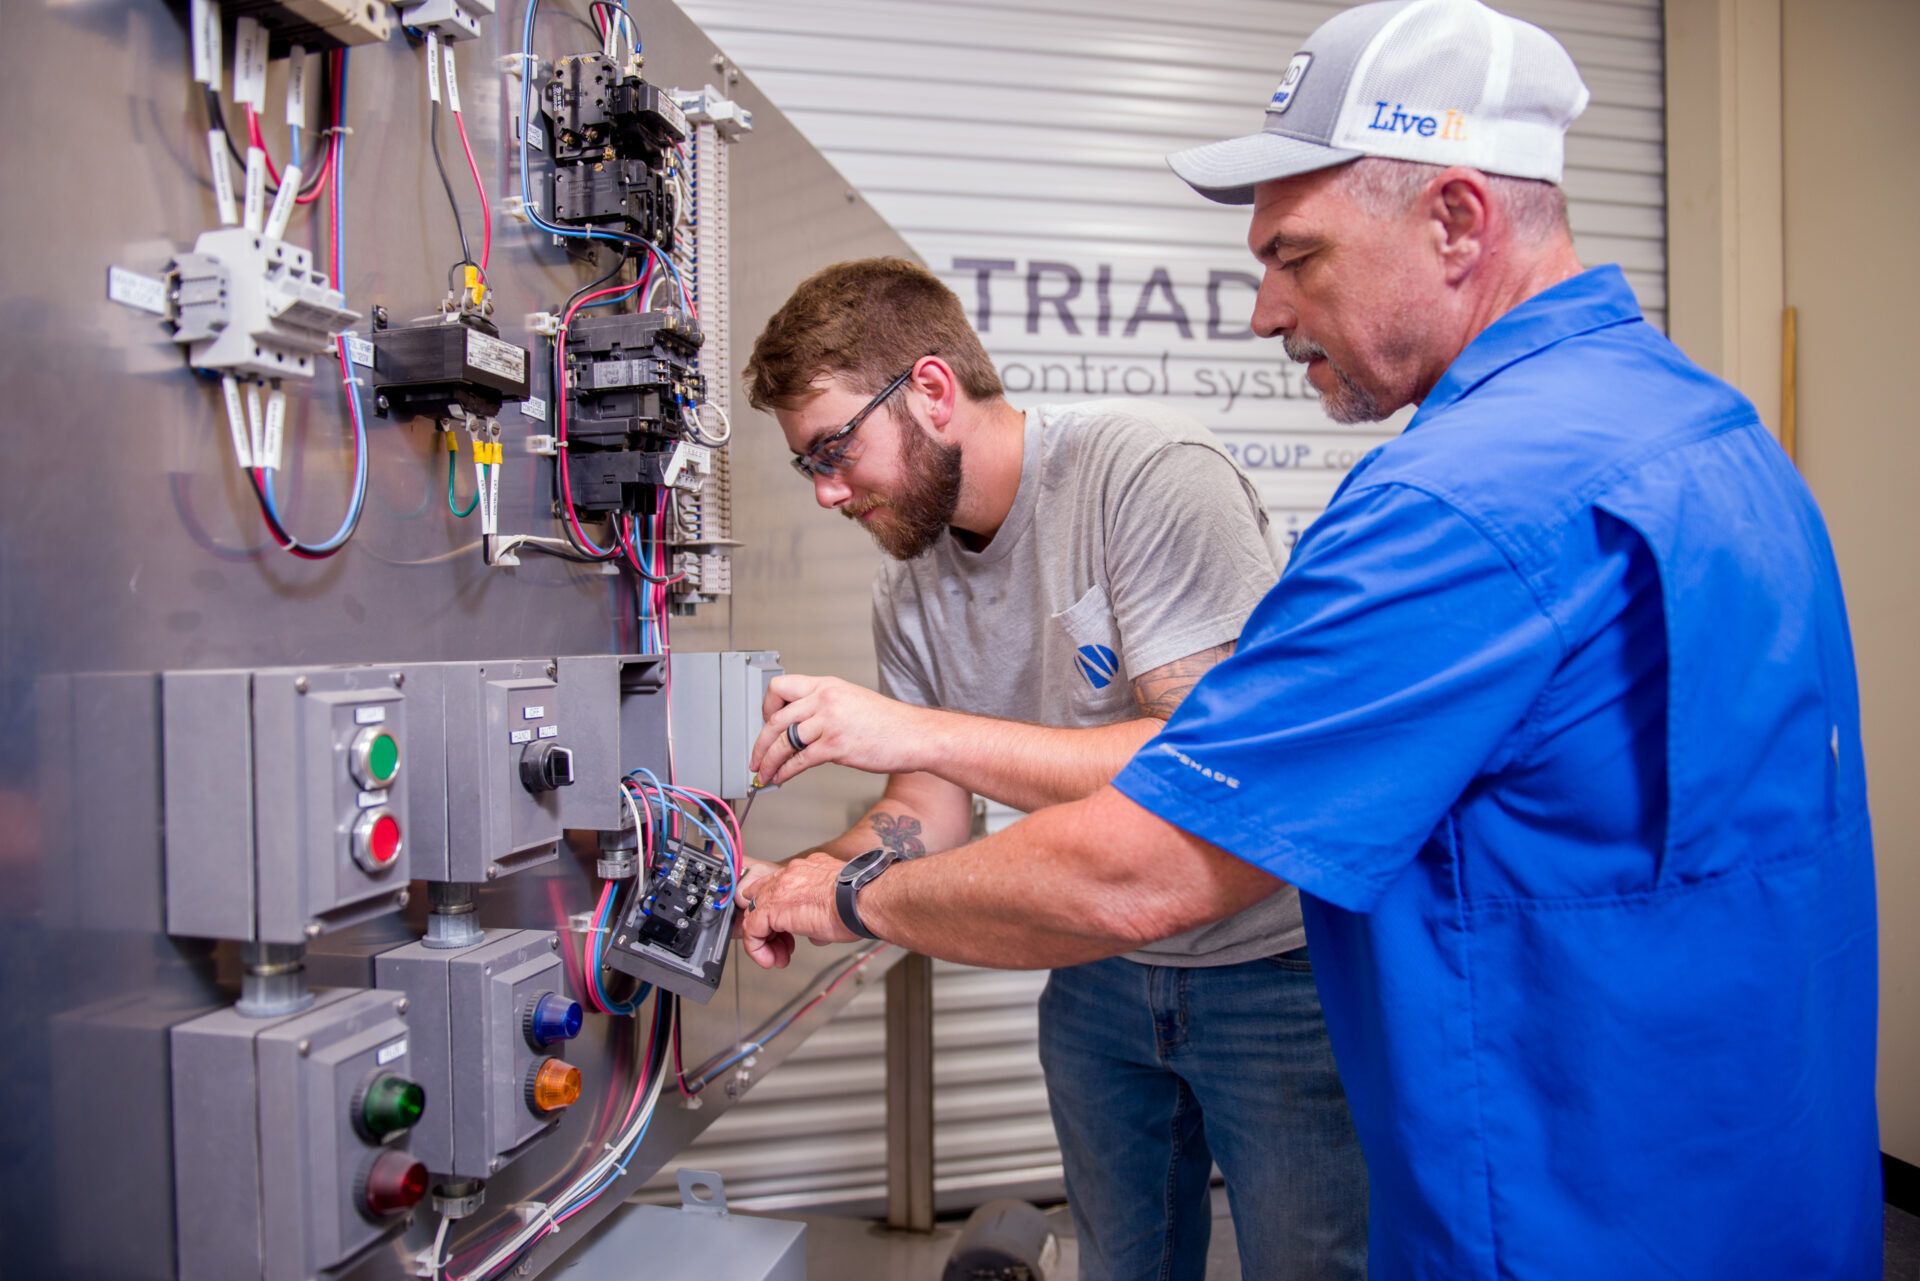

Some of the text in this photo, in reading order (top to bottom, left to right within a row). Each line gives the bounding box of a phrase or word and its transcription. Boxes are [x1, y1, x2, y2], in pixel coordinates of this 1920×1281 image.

[1368, 101, 1437, 136] Live
[952, 257, 1260, 341] TRIAD
[1001, 351, 1321, 414] ontrol syste
[1224, 443, 1311, 468] ROUP
